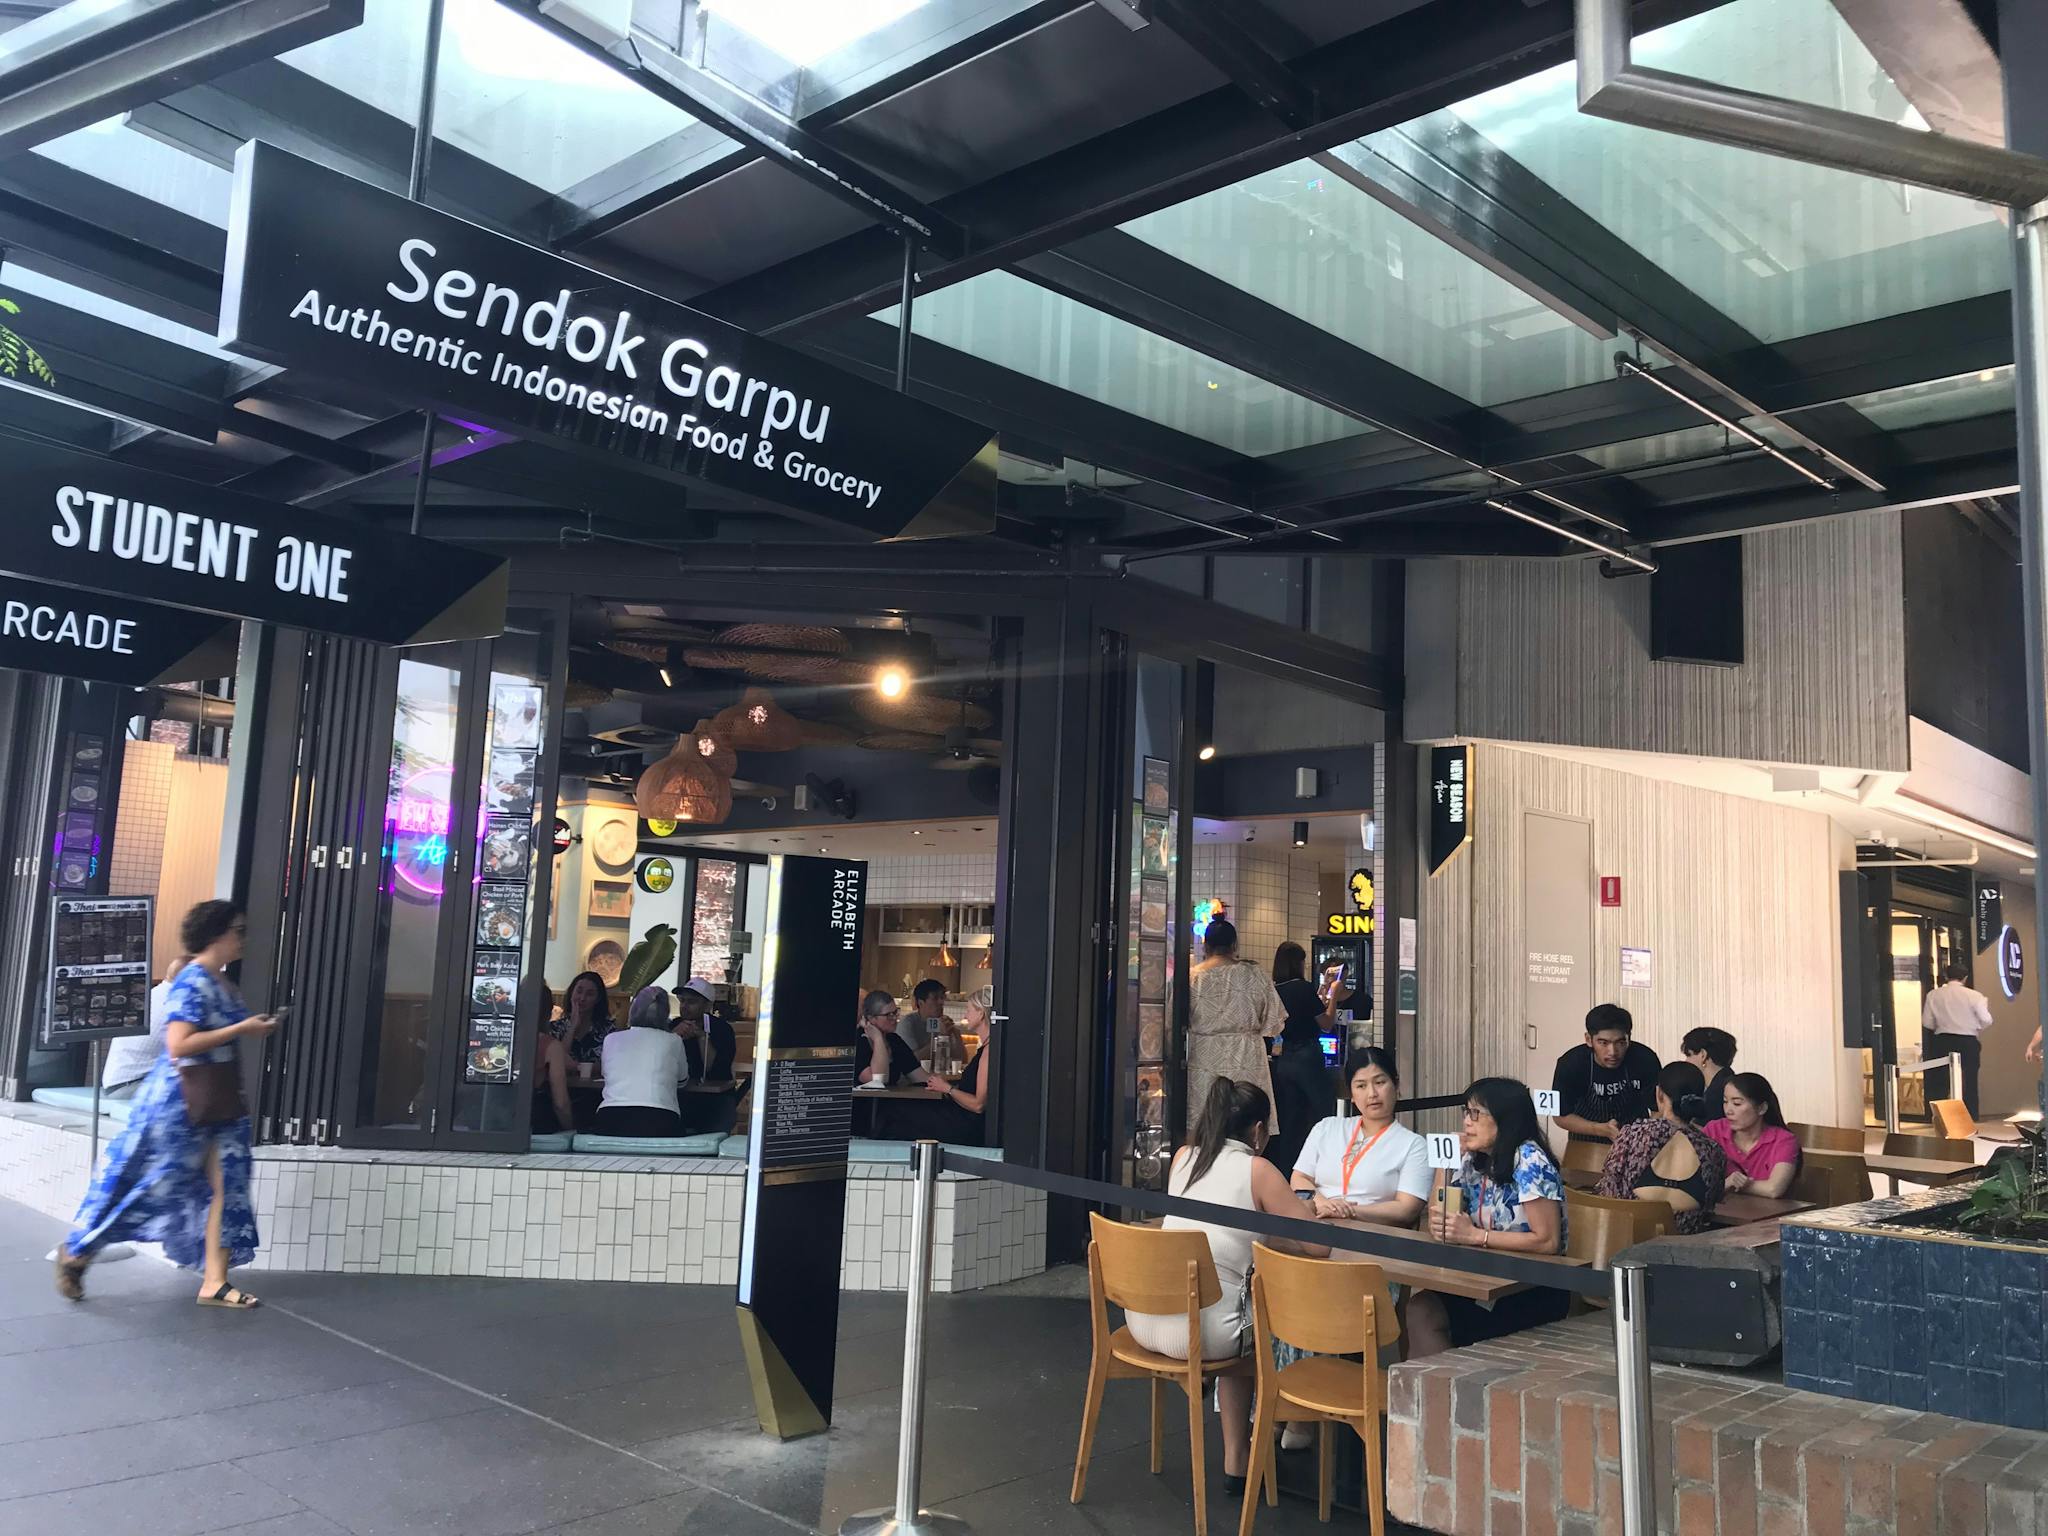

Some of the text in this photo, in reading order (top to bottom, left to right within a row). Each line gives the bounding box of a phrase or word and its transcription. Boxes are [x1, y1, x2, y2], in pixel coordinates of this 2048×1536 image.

[386, 238, 831, 443] Sendok Garpu
[289, 289, 882, 508] Authentic Indonesian Food & Grocery
[51, 485, 353, 603] STUDENT ONE
[1450, 759, 1463, 823] NEW SEASON
[830, 869, 846, 929] ARCADE
[842, 869, 859, 950] ELIZABETH
[1529, 952, 1542, 962] FIRE
[1529, 964, 1541, 974] FIRE
[812, 1048, 849, 1057] STUDENT ONE
[1540, 1092, 1555, 1109] 21
[1434, 1137, 1453, 1160] 10
